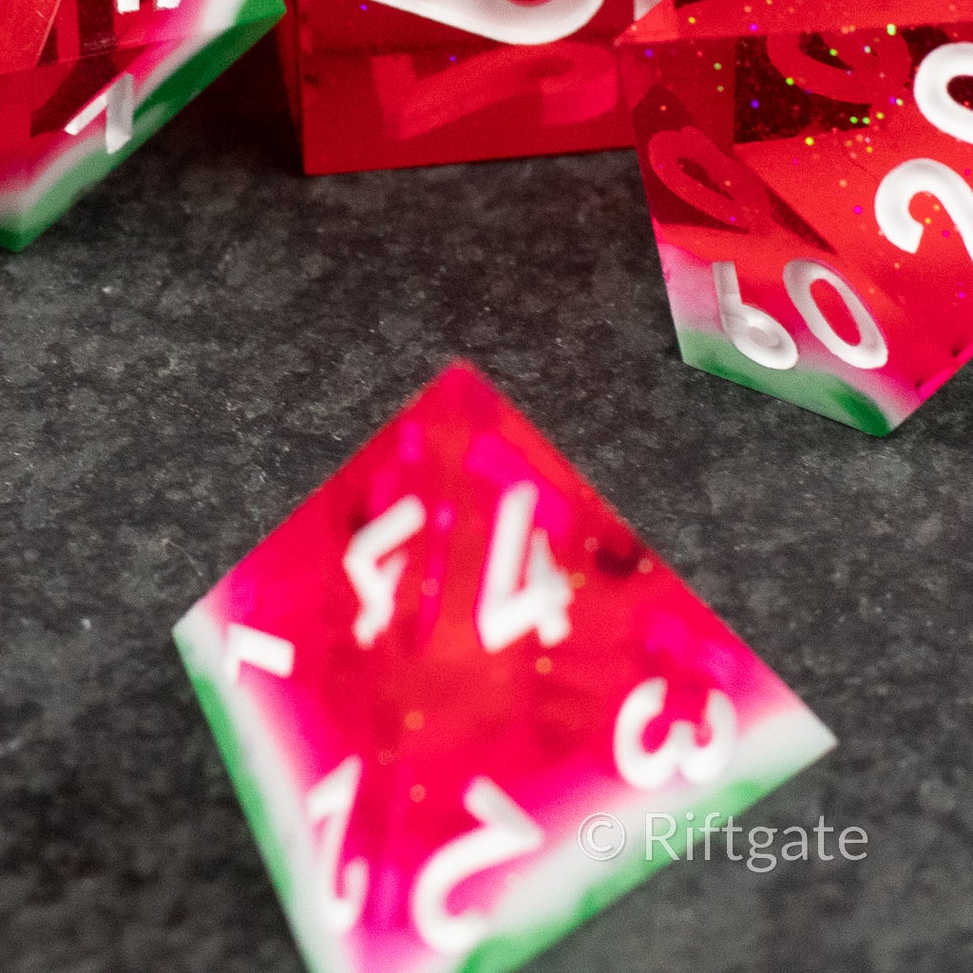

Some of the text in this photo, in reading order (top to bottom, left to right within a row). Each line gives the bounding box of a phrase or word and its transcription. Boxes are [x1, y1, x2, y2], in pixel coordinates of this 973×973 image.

[474, 477, 573, 653] 4
[613, 675, 740, 791] 3
[411, 774, 545, 957] 2
